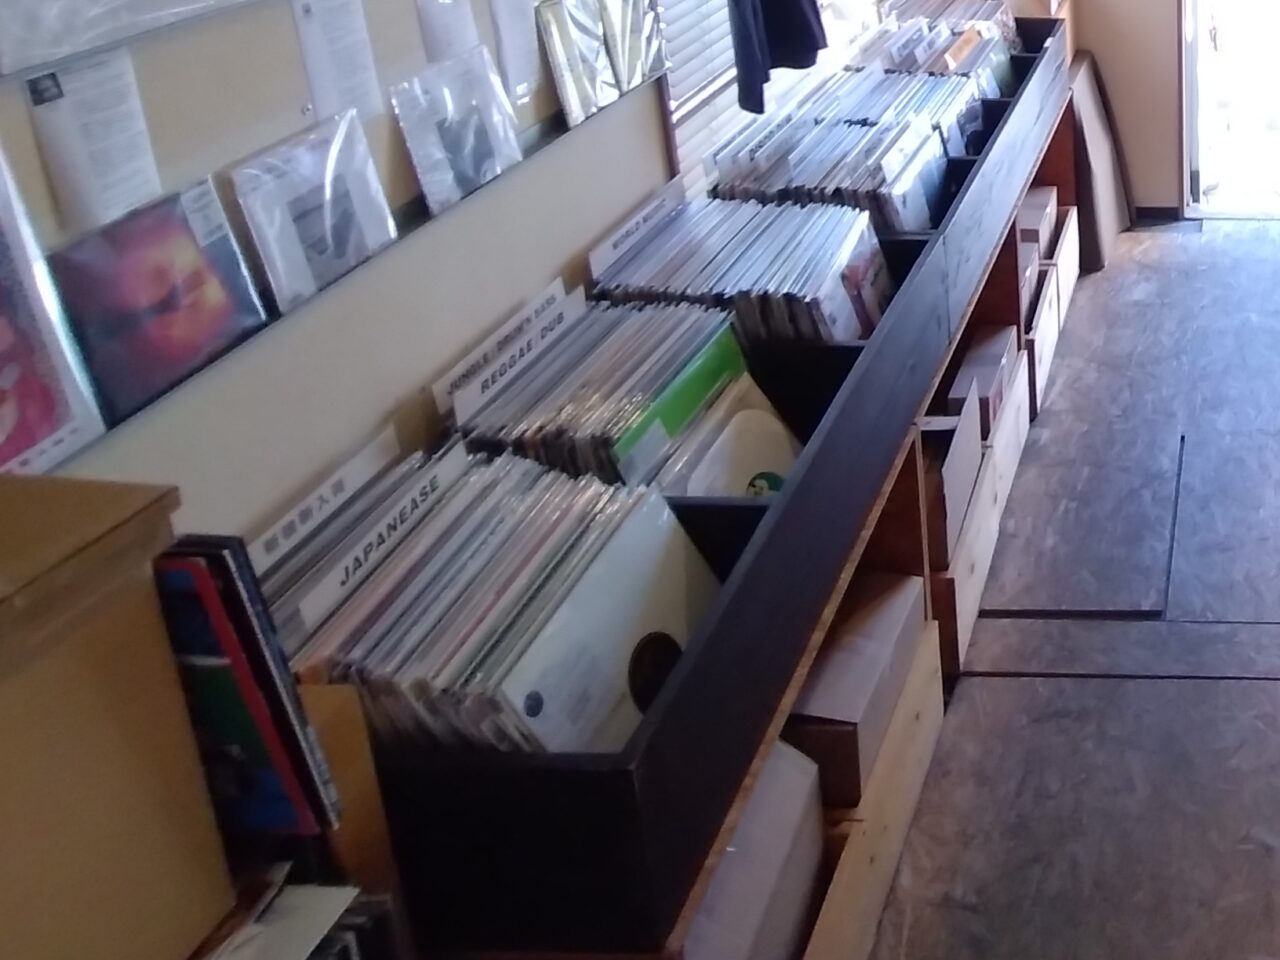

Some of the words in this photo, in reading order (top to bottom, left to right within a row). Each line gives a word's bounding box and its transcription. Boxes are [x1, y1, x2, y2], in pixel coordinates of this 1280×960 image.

[480, 339, 534, 395] REGGAE
[540, 312, 565, 341] DUB
[338, 474, 441, 587] JAPANEASE
